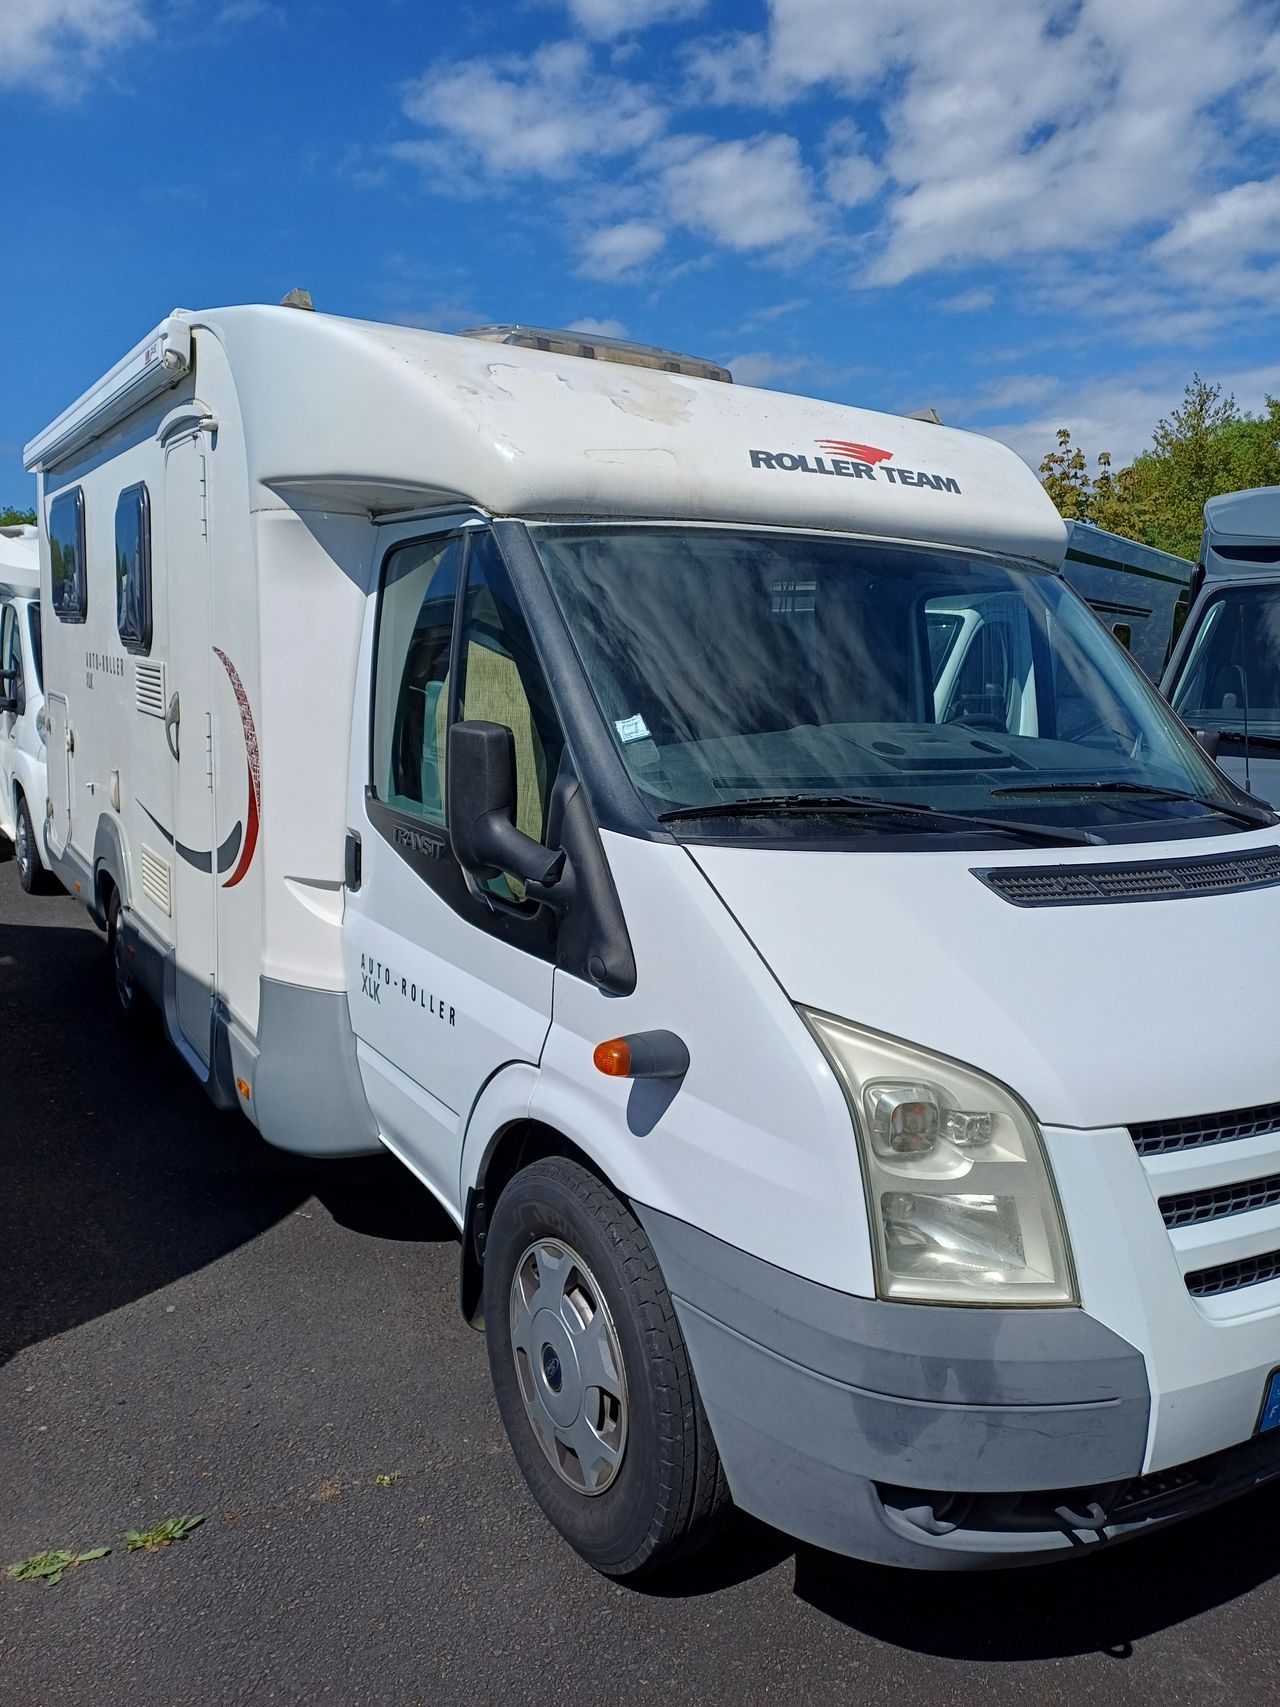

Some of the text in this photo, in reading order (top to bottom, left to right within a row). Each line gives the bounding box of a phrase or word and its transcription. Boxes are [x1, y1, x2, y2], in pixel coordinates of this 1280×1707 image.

[749, 450, 962, 495] ROLLER TEAM
[391, 824, 446, 860] TRANSIT
[361, 972, 381, 1005] XLK
[361, 953, 456, 1027] AUTO-ROLLER
[1269, 1404, 1279, 1418] F
